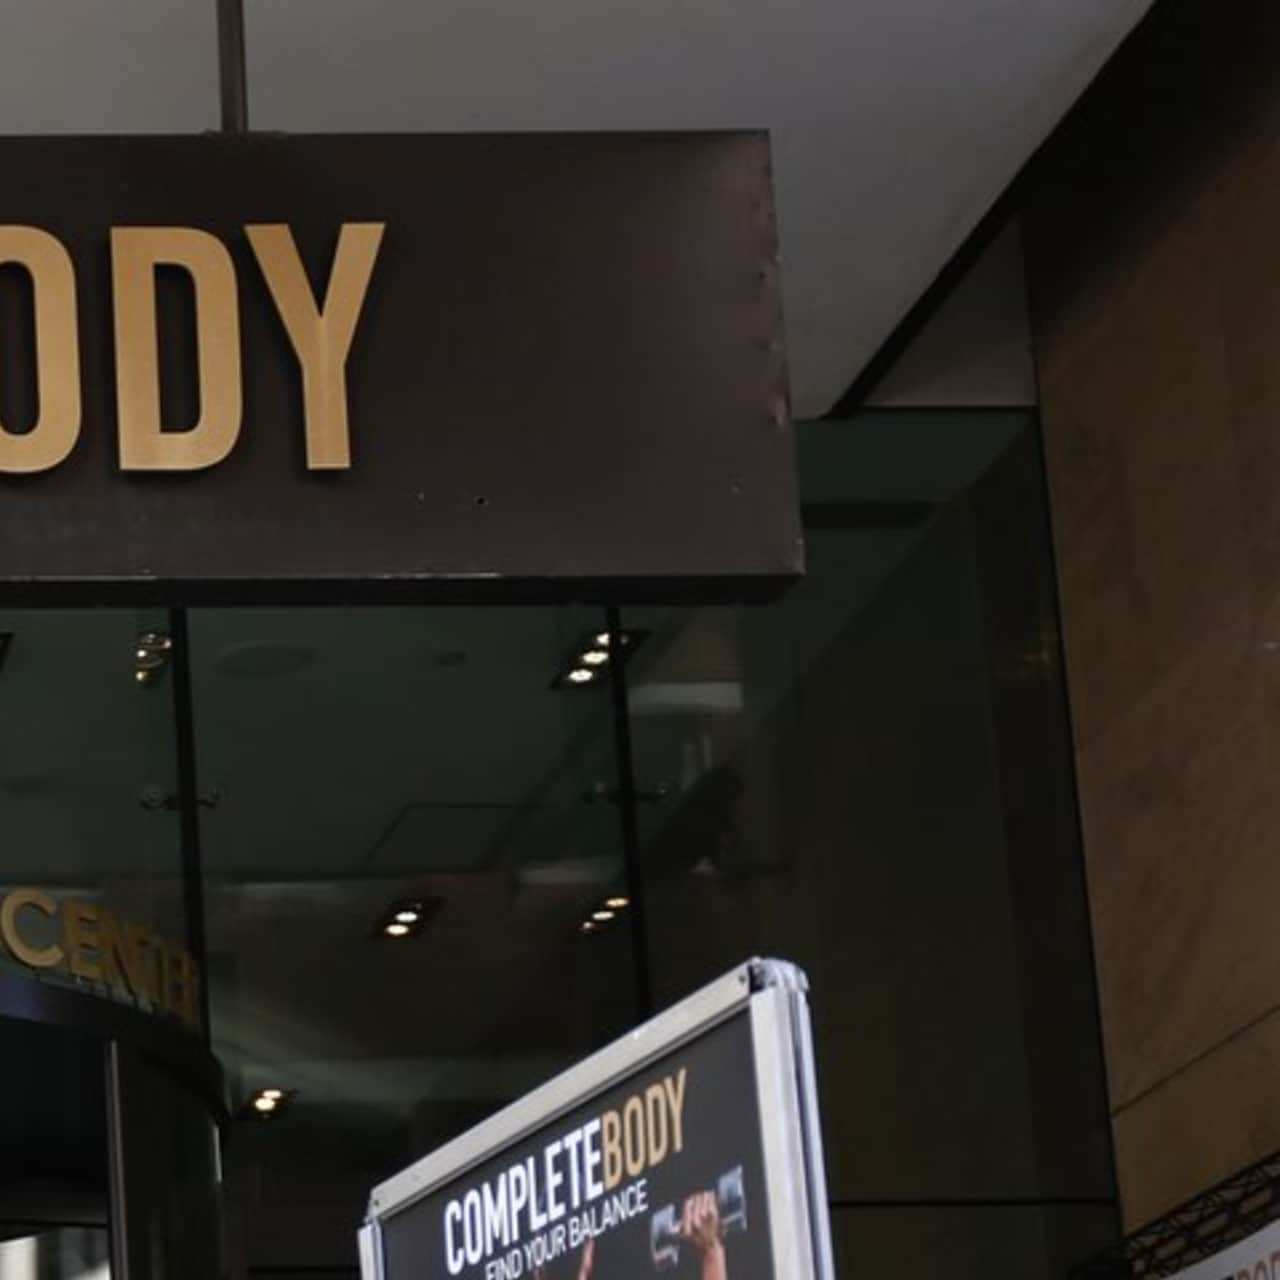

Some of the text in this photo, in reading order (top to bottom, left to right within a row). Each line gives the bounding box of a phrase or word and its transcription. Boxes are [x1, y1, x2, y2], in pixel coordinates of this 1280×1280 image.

[444, 1067, 687, 1276] COMPLETEBODY
[523, 1224, 567, 1272] YOUR
[568, 1177, 649, 1249] BALANCE
